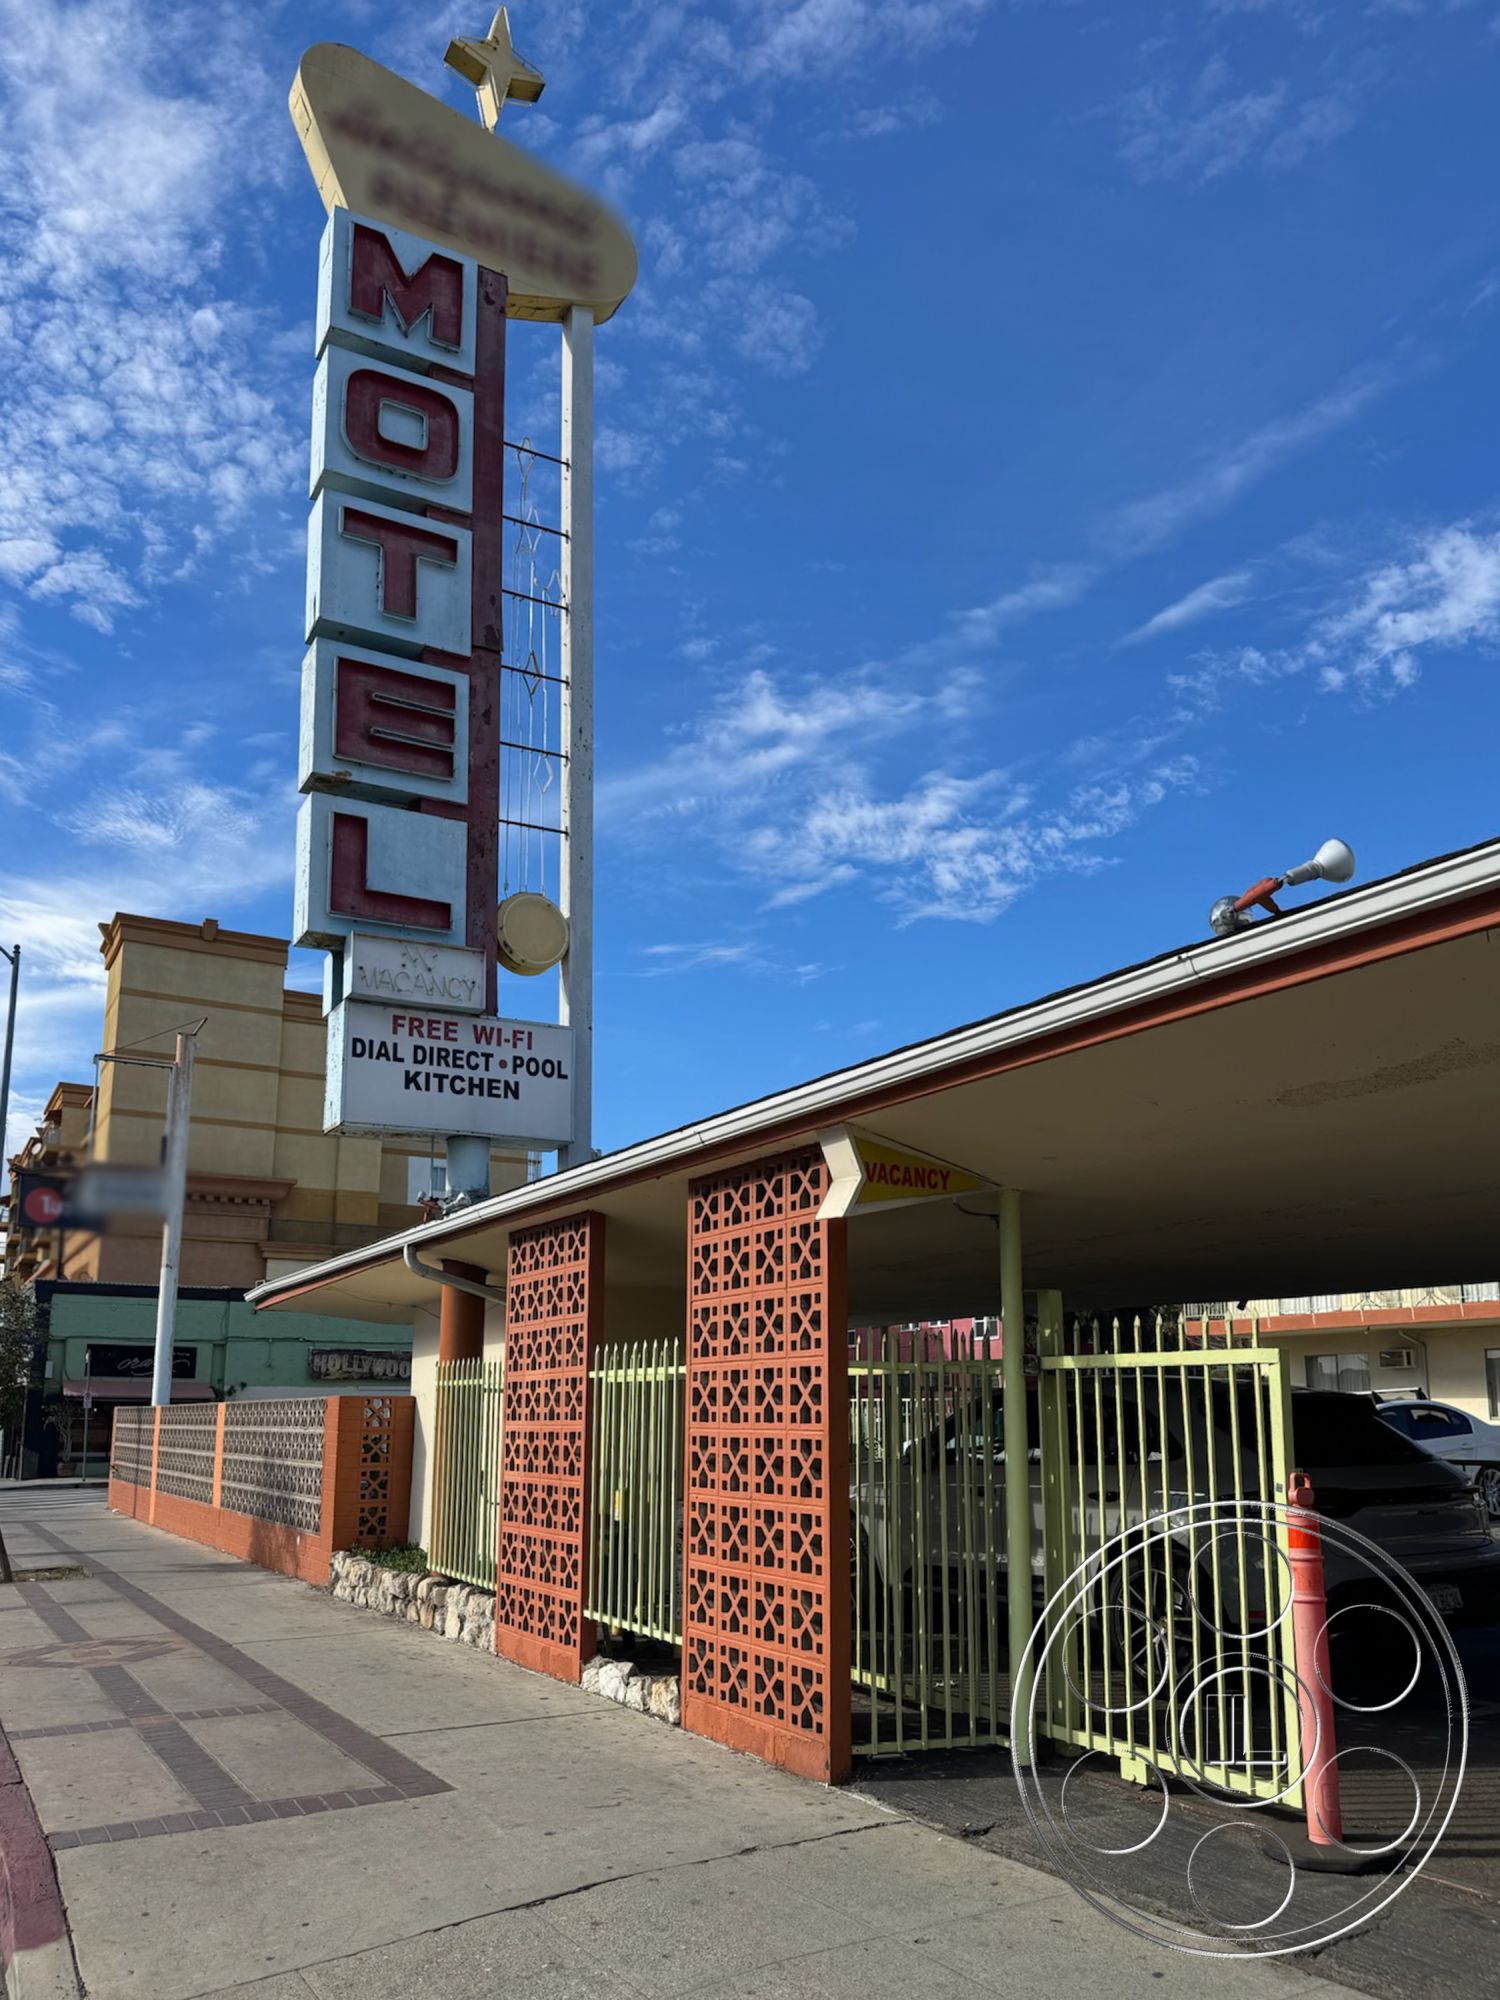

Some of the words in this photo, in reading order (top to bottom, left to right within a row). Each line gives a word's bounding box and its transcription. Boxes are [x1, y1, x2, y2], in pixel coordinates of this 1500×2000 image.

[327, 221, 467, 932] MOTEL
[358, 966, 478, 1003] VACANCY
[391, 1014, 459, 1042] FREE
[472, 1024, 533, 1051] WI-FI
[351, 1037, 405, 1063] DIAL
[412, 1044, 494, 1072] DIRECT
[511, 1054, 569, 1080] POOL
[404, 1070, 520, 1100] KITCHEN
[865, 1161, 951, 1190] VACANCY
[313, 1353, 412, 1378] HOLLYWOO
